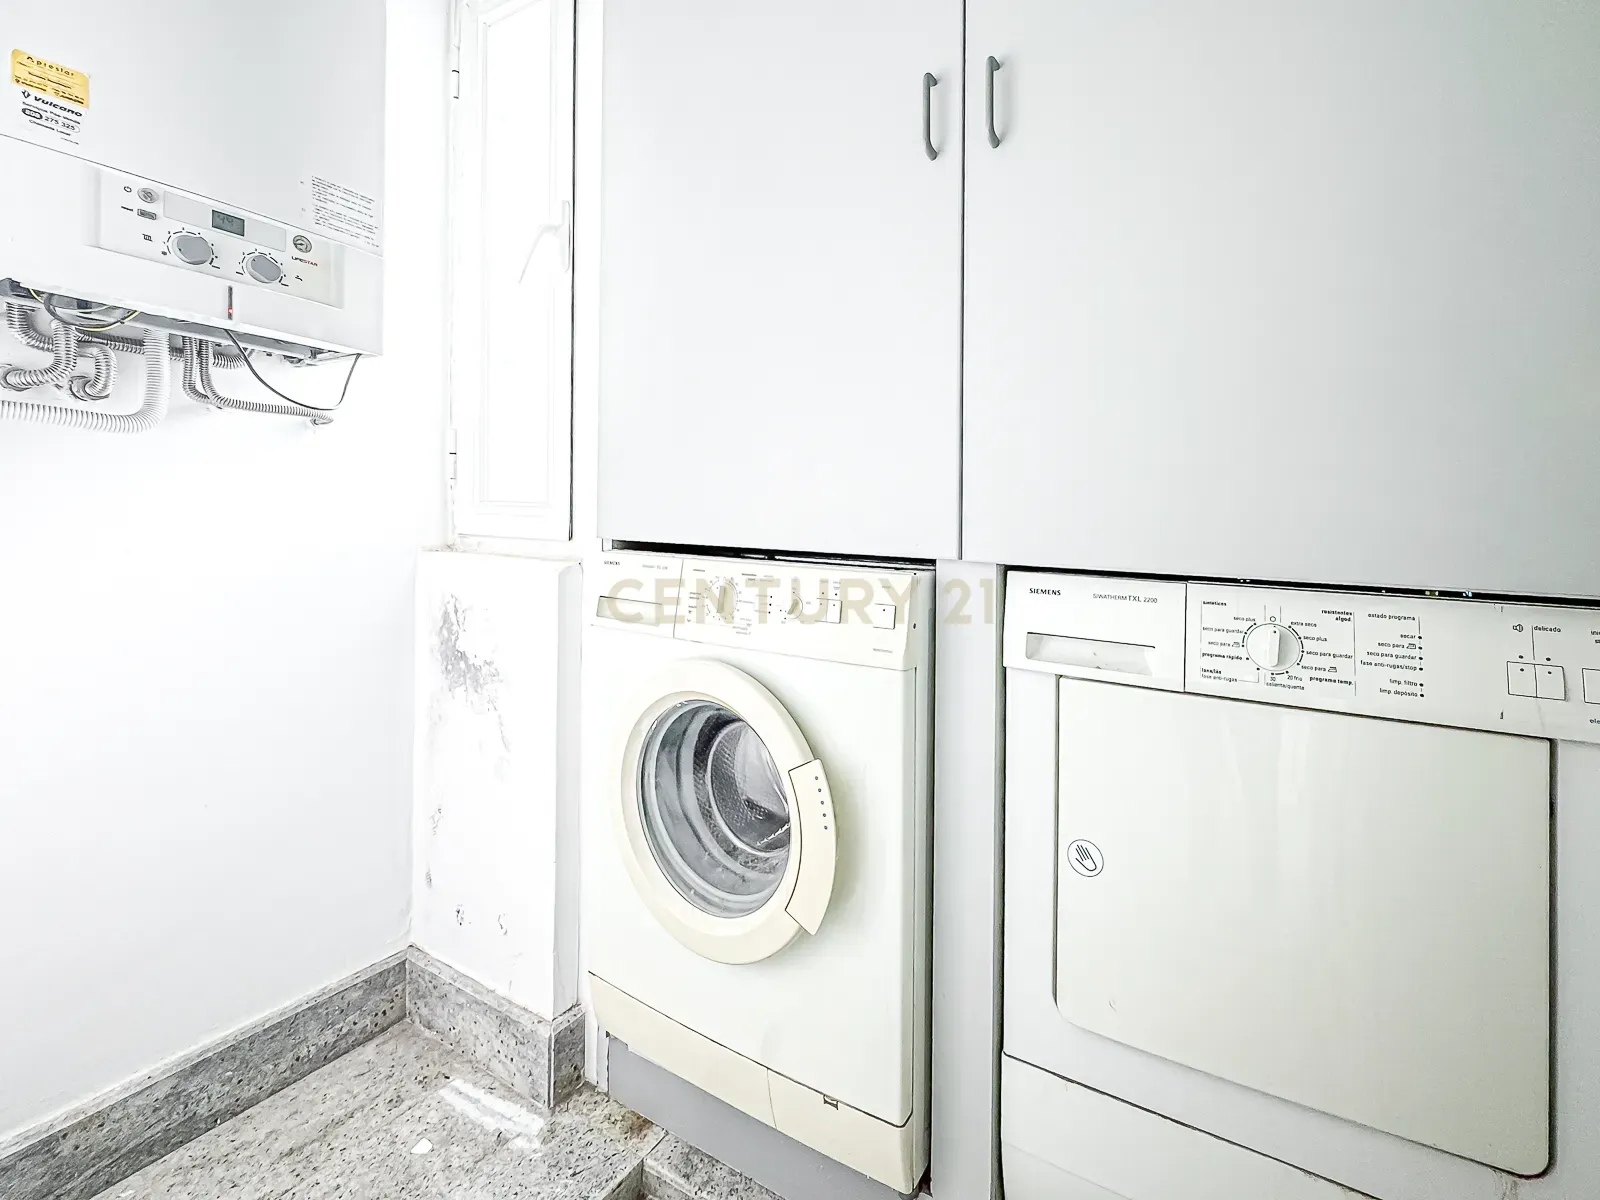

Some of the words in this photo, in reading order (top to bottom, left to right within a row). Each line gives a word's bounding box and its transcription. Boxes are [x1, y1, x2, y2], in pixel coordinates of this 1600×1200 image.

[34, 96, 82, 117] Vulcano
[44, 116, 60, 125] 275
[60, 121, 76, 131] 325
[1029, 588, 1062, 596] SIEMENS
[1533, 625, 1562, 633] delicado
[1202, 652, 1226, 660] programa
[1310, 676, 1336, 684] programa
[1337, 678, 1354, 686] temp.
